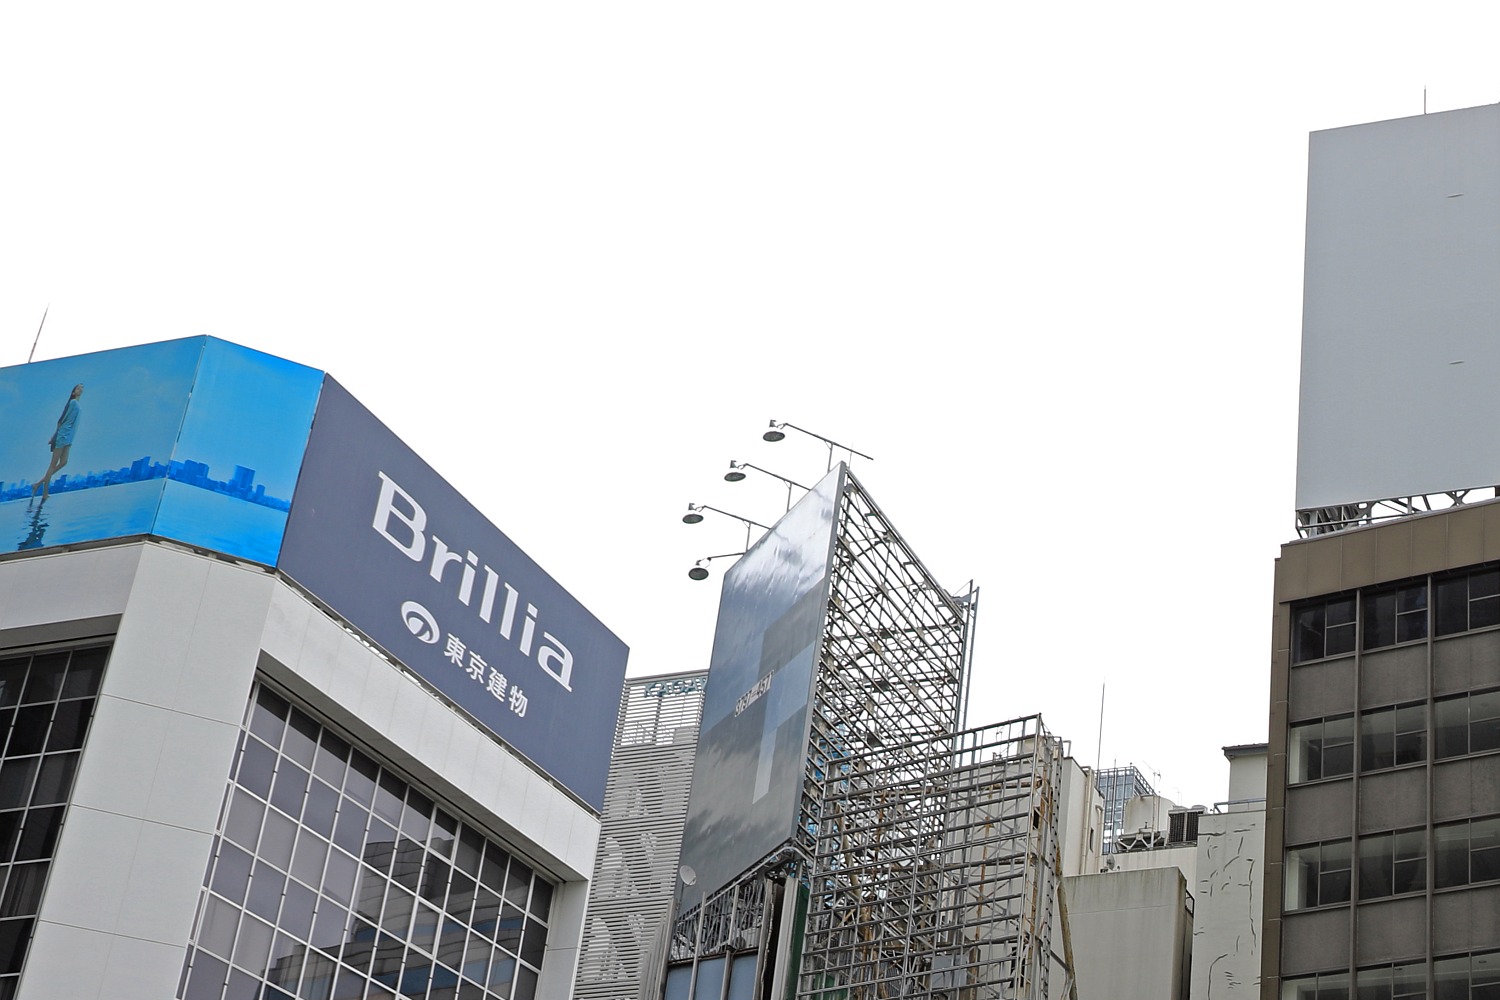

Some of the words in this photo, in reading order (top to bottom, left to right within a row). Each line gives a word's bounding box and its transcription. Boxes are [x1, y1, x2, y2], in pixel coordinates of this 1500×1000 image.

[372, 471, 574, 692] Brillia
[442, 632, 529, 719] 東京建物
